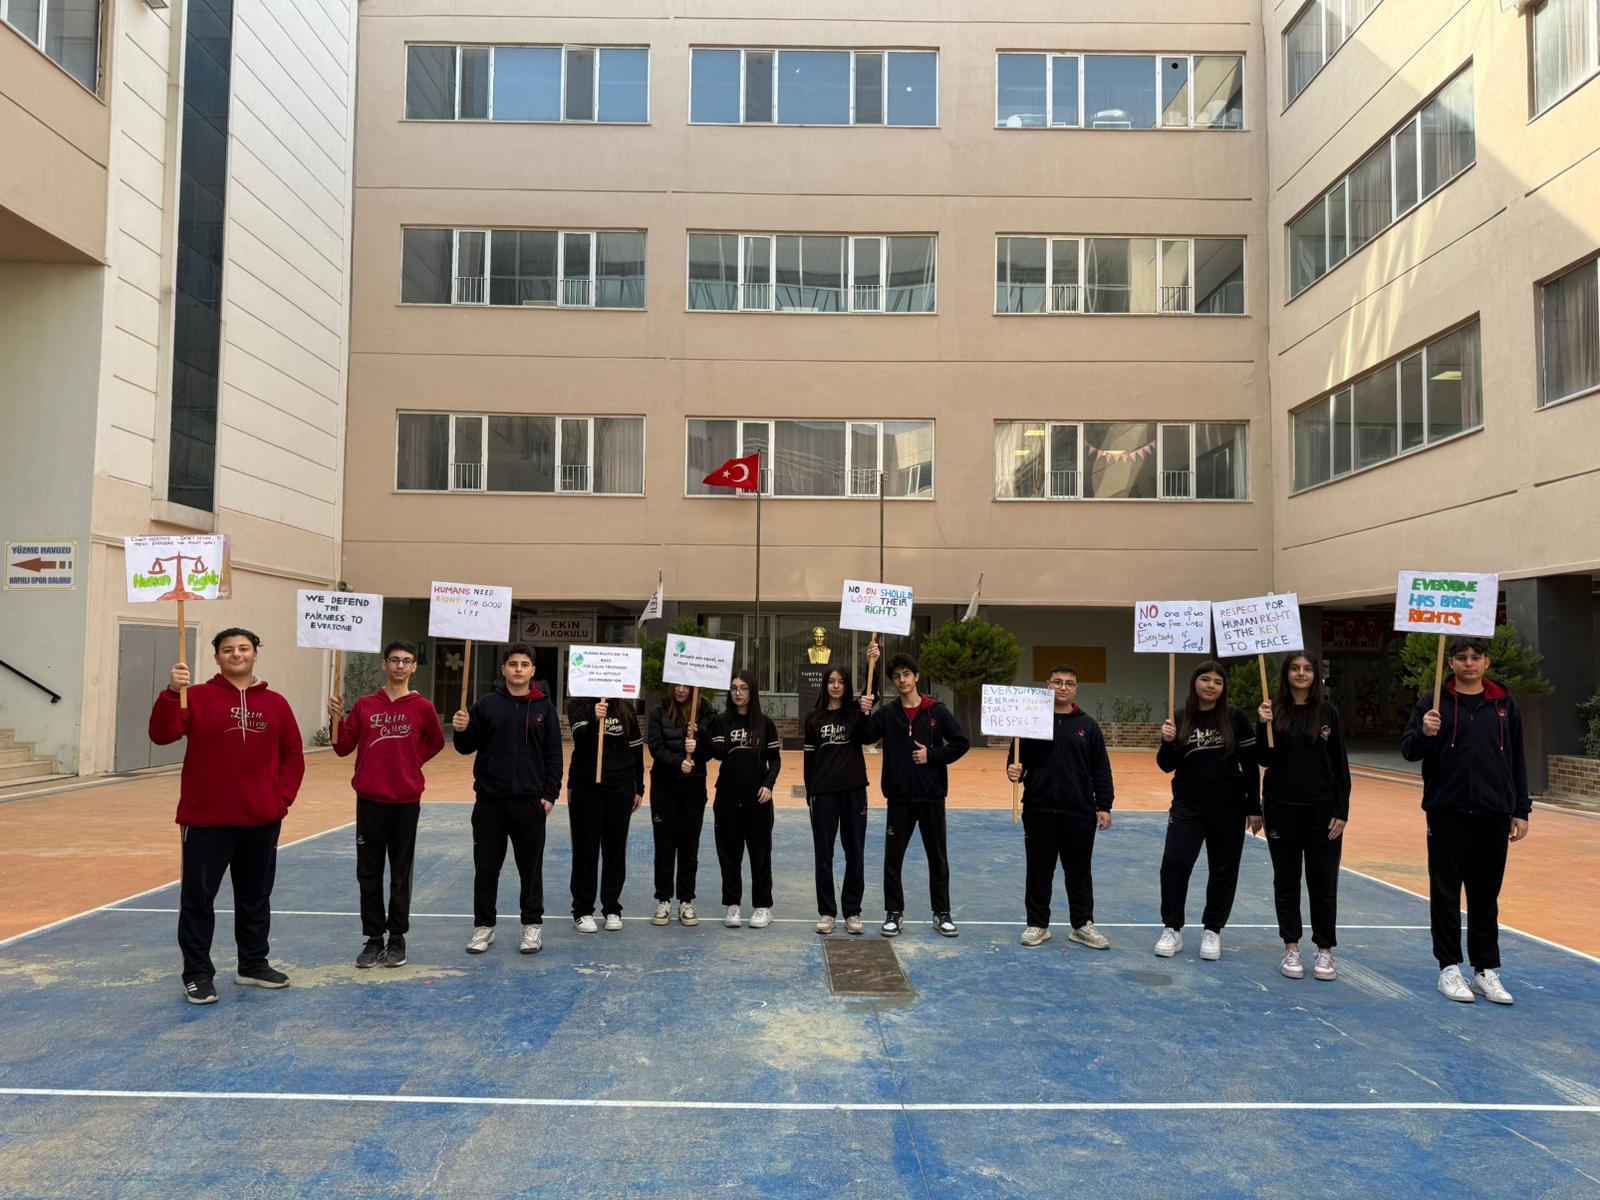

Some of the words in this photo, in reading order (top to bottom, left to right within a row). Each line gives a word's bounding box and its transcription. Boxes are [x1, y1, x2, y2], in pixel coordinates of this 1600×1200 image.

[12, 545, 39, 554] YÜZME
[41, 546, 71, 554] HAVUZU
[9, 576, 30, 585] KAPALI
[31, 576, 47, 585] SPOR
[48, 576, 71, 585] SALONU
[434, 586, 470, 595] HUMANS
[473, 588, 494, 596] NEED
[866, 587, 877, 595] ON
[880, 588, 913, 599] SHOULD
[306, 594, 325, 603] WE
[331, 596, 370, 607] DEFEND
[465, 599, 479, 607] FOR
[482, 601, 502, 609] GOOD
[850, 595, 874, 604] LOSE
[880, 598, 907, 607] THEIR
[1408, 593, 1435, 607] HAS
[457, 608, 479, 616] LIFE
[1140, 605, 1159, 620] NO
[1220, 604, 1258, 617] RESPECT
[1265, 600, 1284, 610] FOR
[351, 616, 363, 624] TO
[551, 621, 580, 629] EKİN
[1222, 617, 1258, 630] HUMAN
[1260, 610, 1290, 624] RIGHT
[310, 622, 353, 632] EVERYONE
[1224, 631, 1232, 640] IS
[1233, 627, 1255, 638] THE
[1259, 623, 1280, 635] KEY
[542, 630, 589, 638] İLKOKULU
[1227, 641, 1248, 652] TO
[1255, 635, 1290, 649] PEACE
[370, 711, 407, 728] Ekin
[990, 714, 1039, 728] RESPECT
